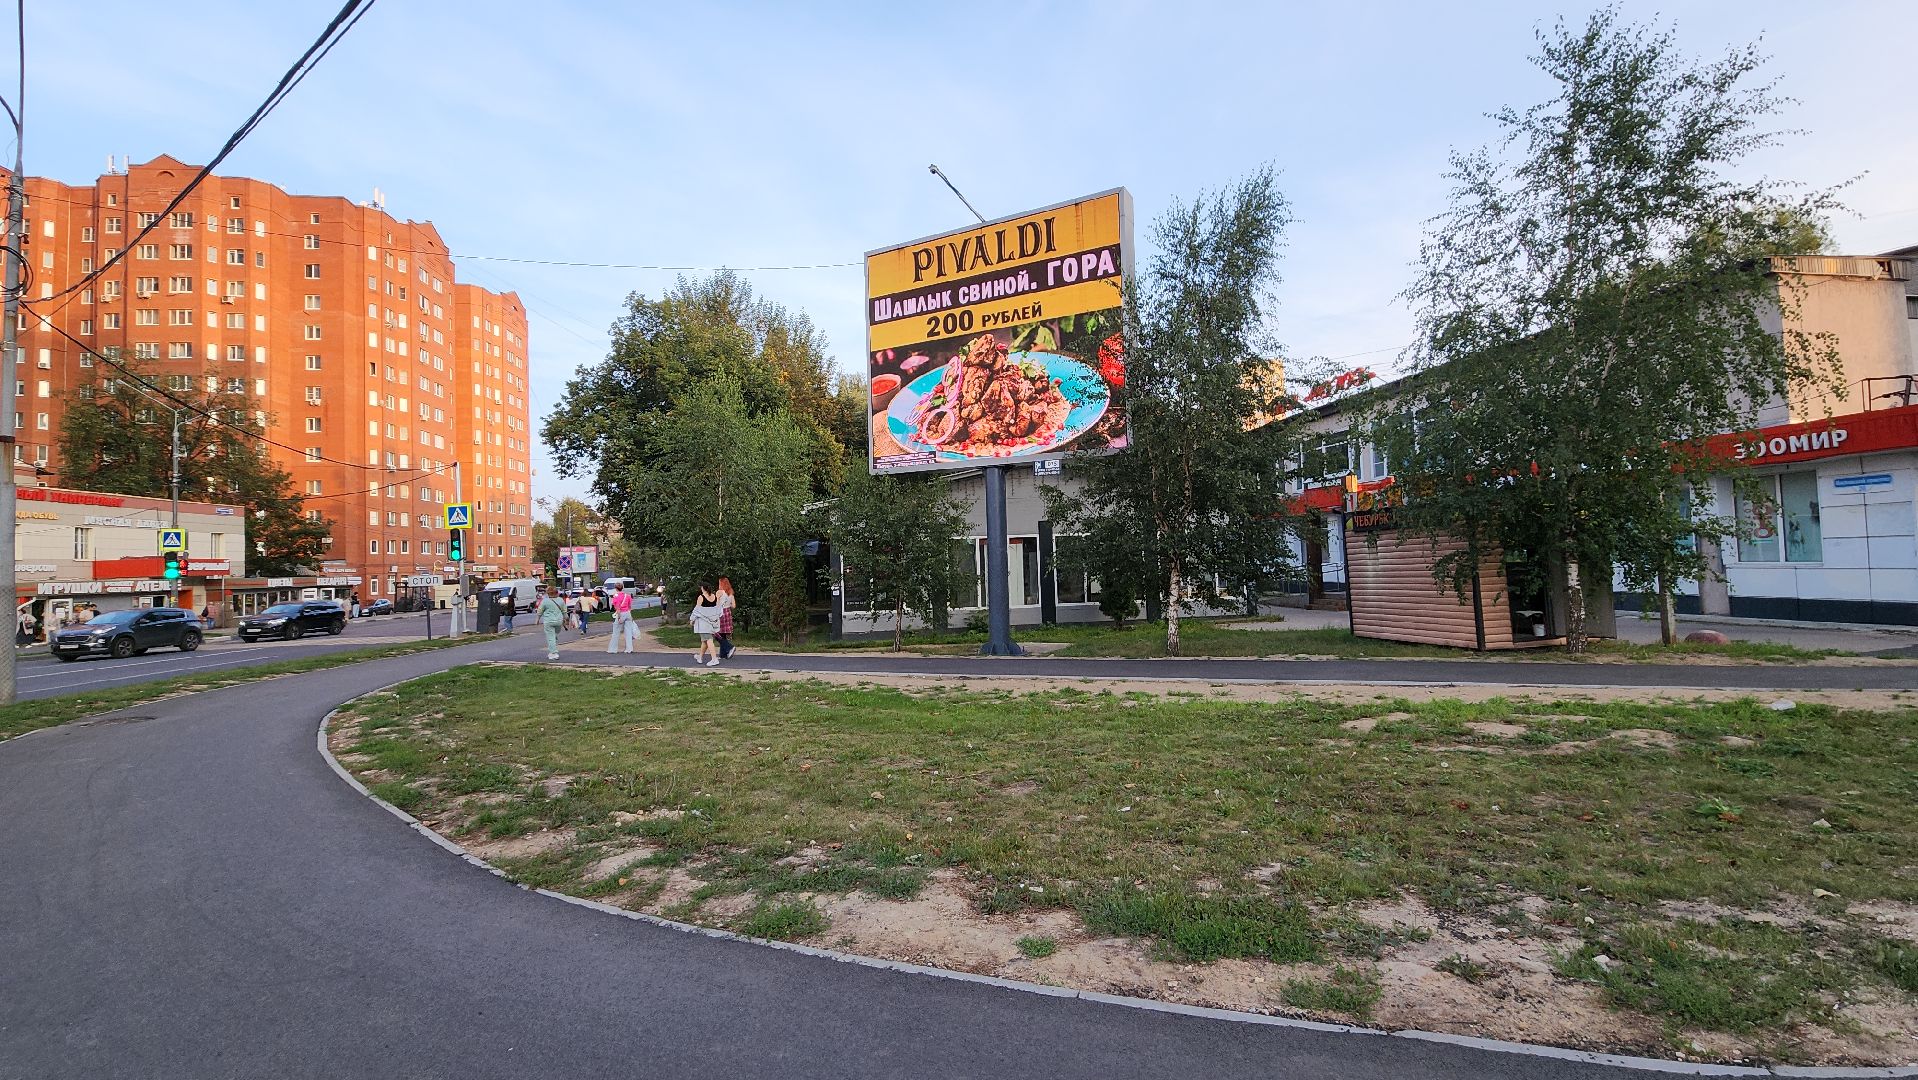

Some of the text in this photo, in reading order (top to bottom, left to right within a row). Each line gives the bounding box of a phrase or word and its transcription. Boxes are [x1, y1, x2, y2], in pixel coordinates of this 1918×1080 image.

[912, 216, 1057, 283] PIVALDI
[1047, 250, 1116, 286] ГОРА
[926, 309, 974, 338] 200
[1732, 429, 1848, 459] ЗООМИР
[37, 581, 102, 595] ИГРУШКИ
[412, 577, 439, 585] СТОП
